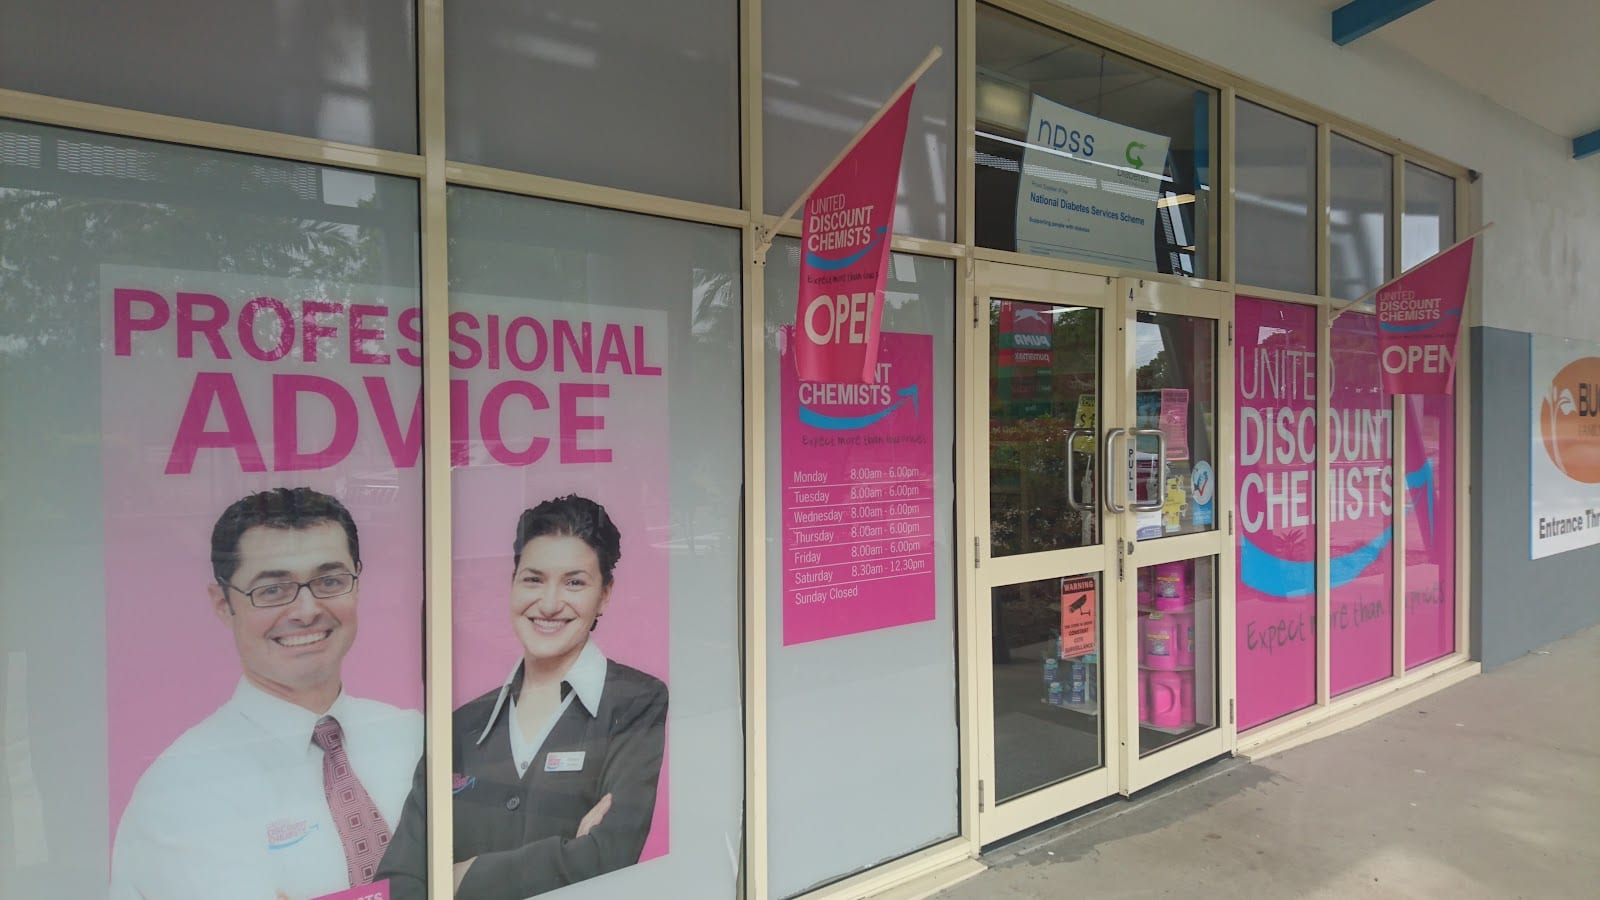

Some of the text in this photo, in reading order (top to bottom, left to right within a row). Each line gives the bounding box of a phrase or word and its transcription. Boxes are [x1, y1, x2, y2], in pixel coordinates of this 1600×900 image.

[811, 194, 846, 215] UNITED
[1030, 192, 1144, 226] National Diabetes Services Scheme
[809, 206, 874, 234] DISCOUNT
[807, 226, 871, 252] CHEMISTS
[1380, 290, 1415, 300] UNITED
[1380, 298, 1442, 312] DISCOUNT
[1380, 310, 1440, 322] CHEMISTS
[114, 288, 662, 377] PROFESSIONAL
[1240, 346, 1335, 400] UNITE
[798, 382, 892, 405] CHEMISTS
[1579, 382, 1600, 417] BU
[164, 371, 613, 475] ADVICE
[793, 471, 828, 484] Monday
[850, 468, 882, 480] 8.00am
[889, 466, 919, 478] 6.00pm
[794, 490, 830, 504] Tuesday
[850, 486, 882, 500] 8.00am
[889, 484, 919, 498] 6.00pm
[794, 510, 843, 523] Wednesday
[851, 507, 882, 519] 8.00am
[889, 504, 920, 516] 6.00pm
[795, 530, 834, 543] Thursday
[851, 525, 882, 538] 8.00am
[889, 522, 920, 534] 6.00pm
[1539, 516, 1583, 540] Entrance
[794, 552, 821, 565] Friday
[851, 545, 883, 557] 8.00am
[890, 541, 920, 553] 6.00pm
[795, 571, 833, 584] Saturday
[851, 565, 883, 577] 8.30am
[890, 558, 925, 572] 12.30pm
[795, 586, 858, 605] Sunday Closed
[1064, 581, 1094, 591] WARNING
[1247, 614, 1305, 654] Expect
[1354, 594, 1383, 628] than
